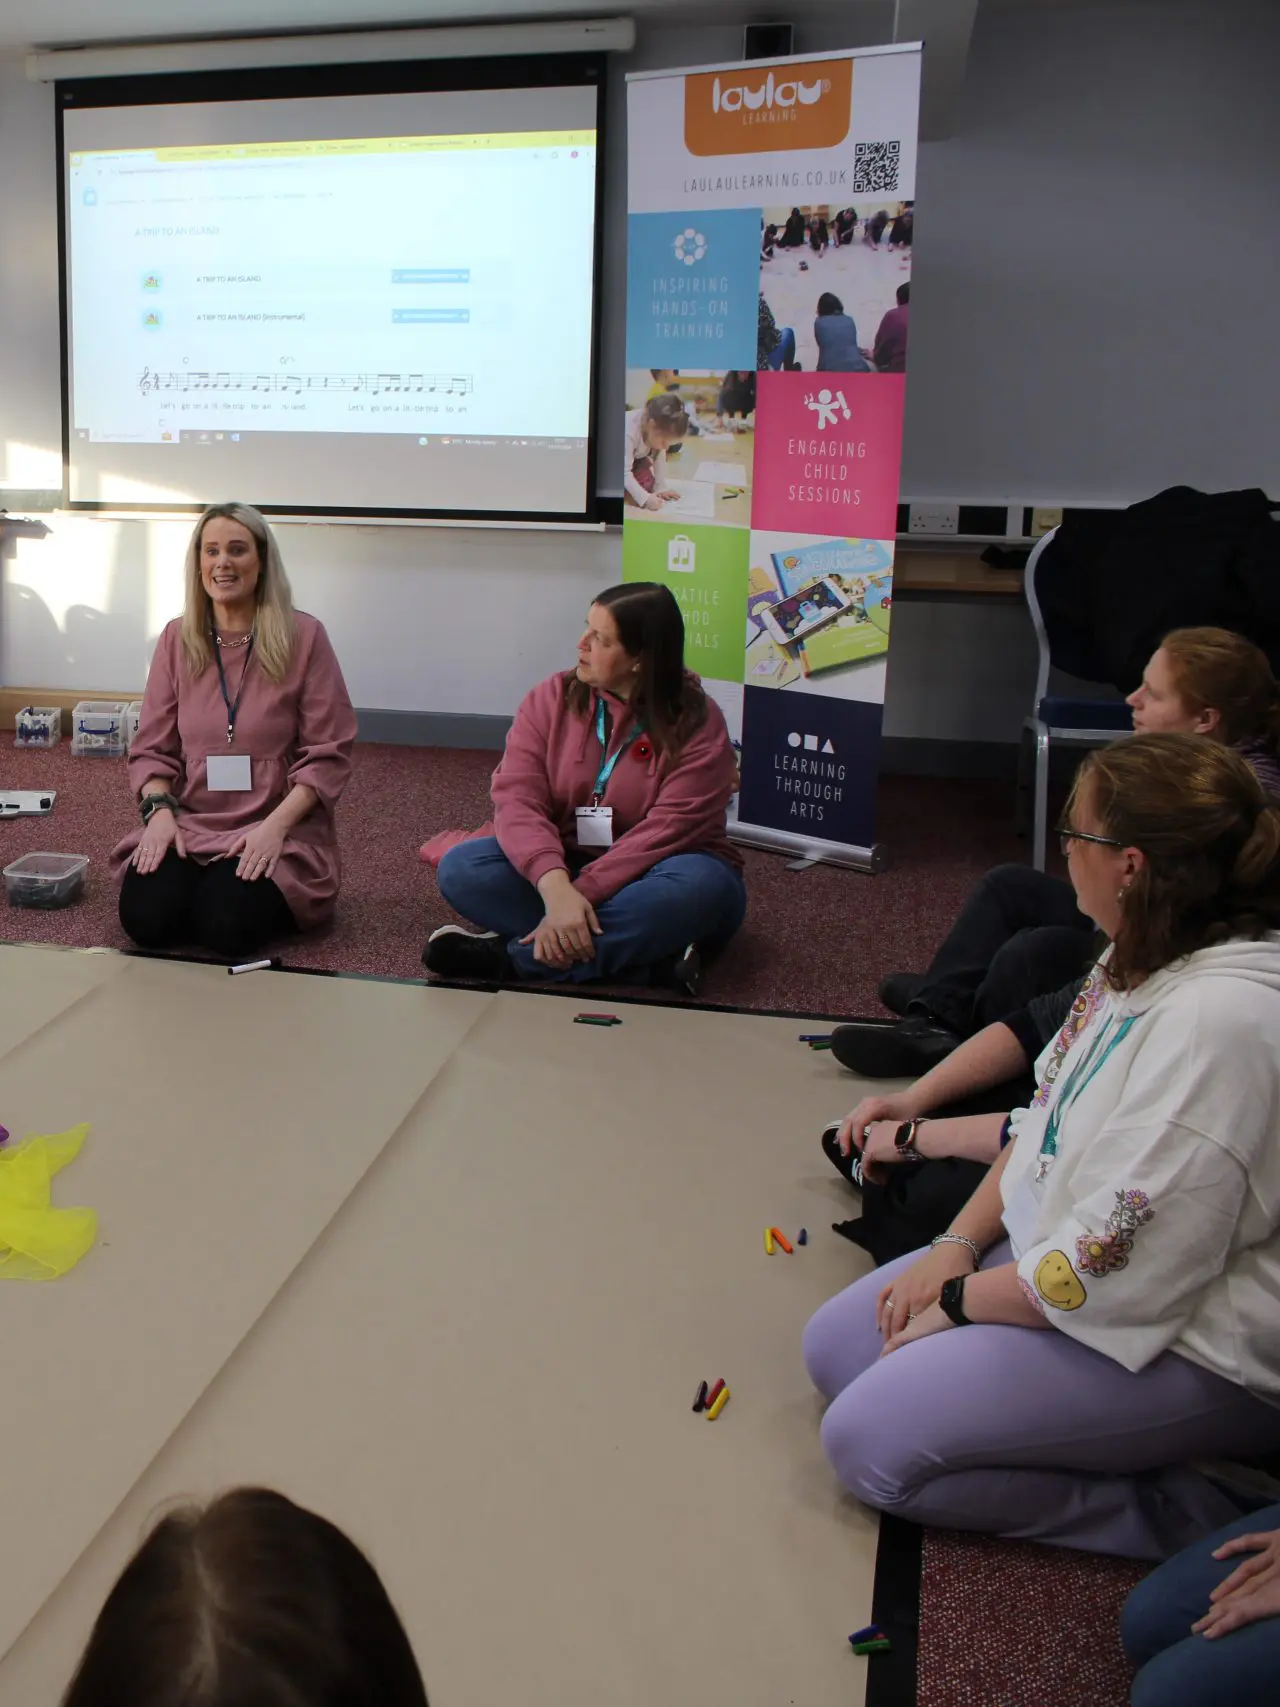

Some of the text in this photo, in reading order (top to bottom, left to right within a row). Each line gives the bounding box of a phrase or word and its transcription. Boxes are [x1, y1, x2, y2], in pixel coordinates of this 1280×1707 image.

[742, 109, 797, 126] LEARNING
[683, 169, 848, 193] LAULAULEARNING.CO.UK
[652, 276, 729, 295] INSPIRING
[652, 300, 729, 317] HANDS-ON
[654, 322, 725, 339] TRAINING
[788, 438, 867, 458] ENGAGING
[804, 462, 848, 482] CHILD
[788, 484, 862, 505] SESSIONS
[673, 587, 720, 606] SATILE
[683, 609, 710, 626] HOD
[774, 754, 847, 781] LEARNING
[776, 776, 843, 803] THROUGH
[790, 801, 825, 821] ARTS
